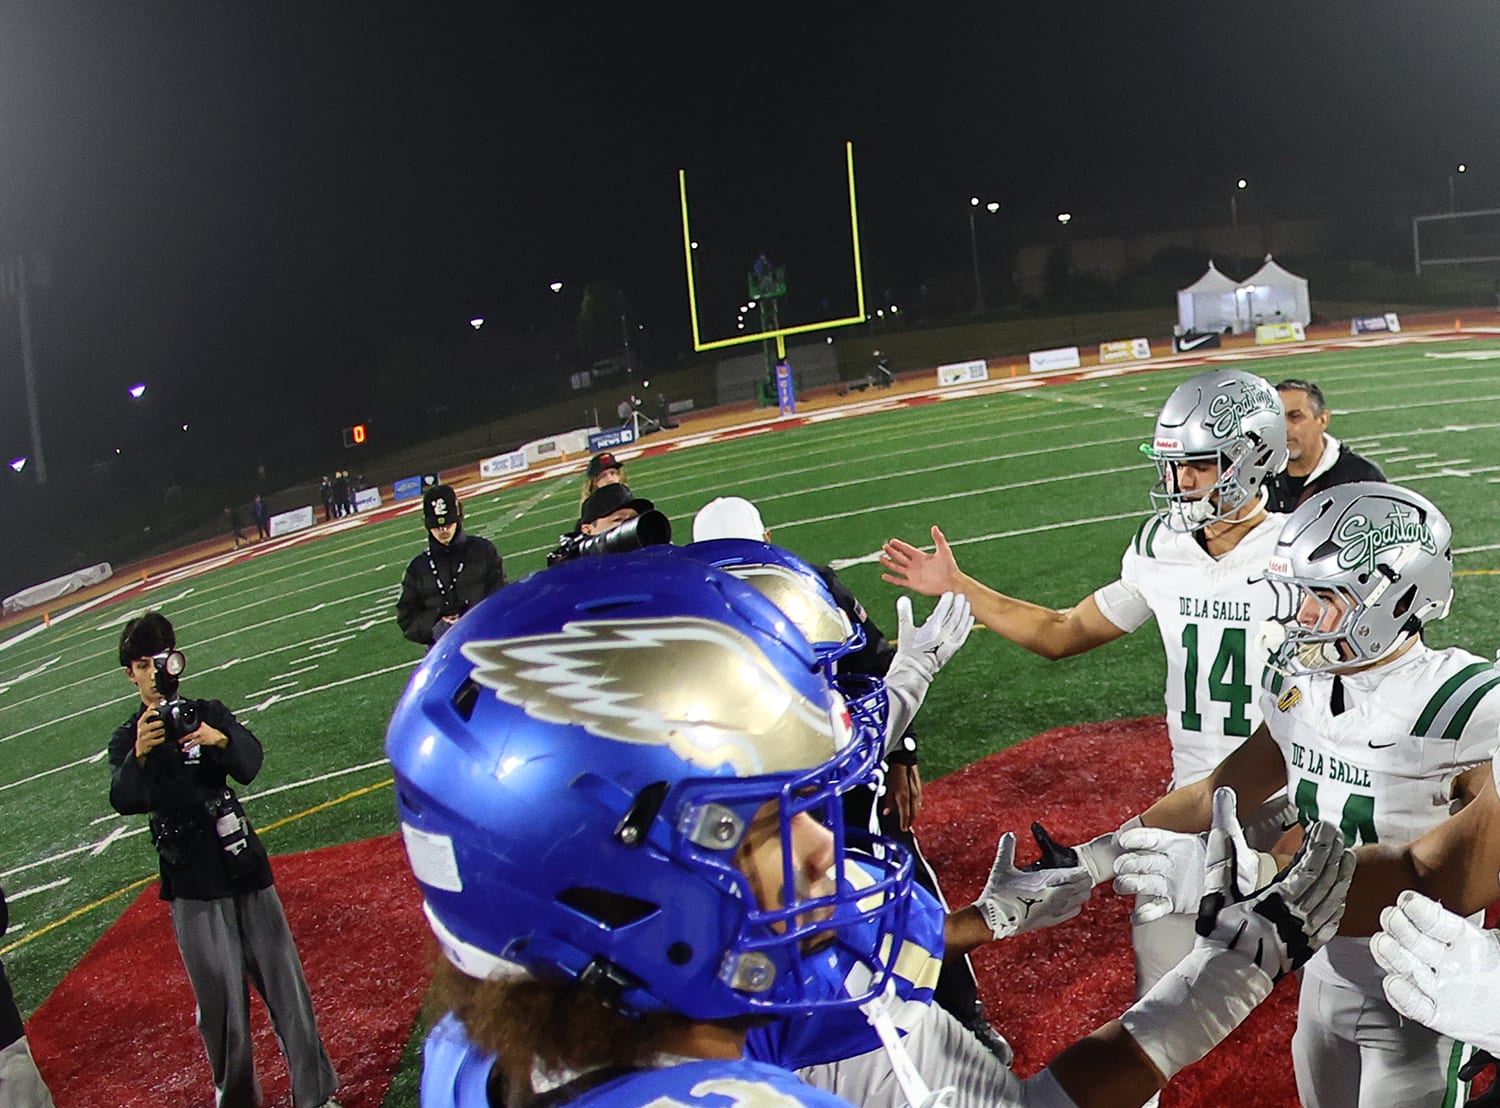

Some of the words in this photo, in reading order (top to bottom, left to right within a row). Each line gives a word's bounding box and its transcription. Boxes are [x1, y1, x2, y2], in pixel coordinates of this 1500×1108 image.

[1337, 503, 1437, 577] Spartans
[1179, 597, 1192, 616] DE
[1194, 599, 1209, 619] LA
[1213, 600, 1251, 622] SALLE
[1181, 623, 1252, 738] 14
[1291, 742, 1305, 769] DE
[1307, 749, 1325, 776] LA
[1329, 757, 1372, 788] SALLE
